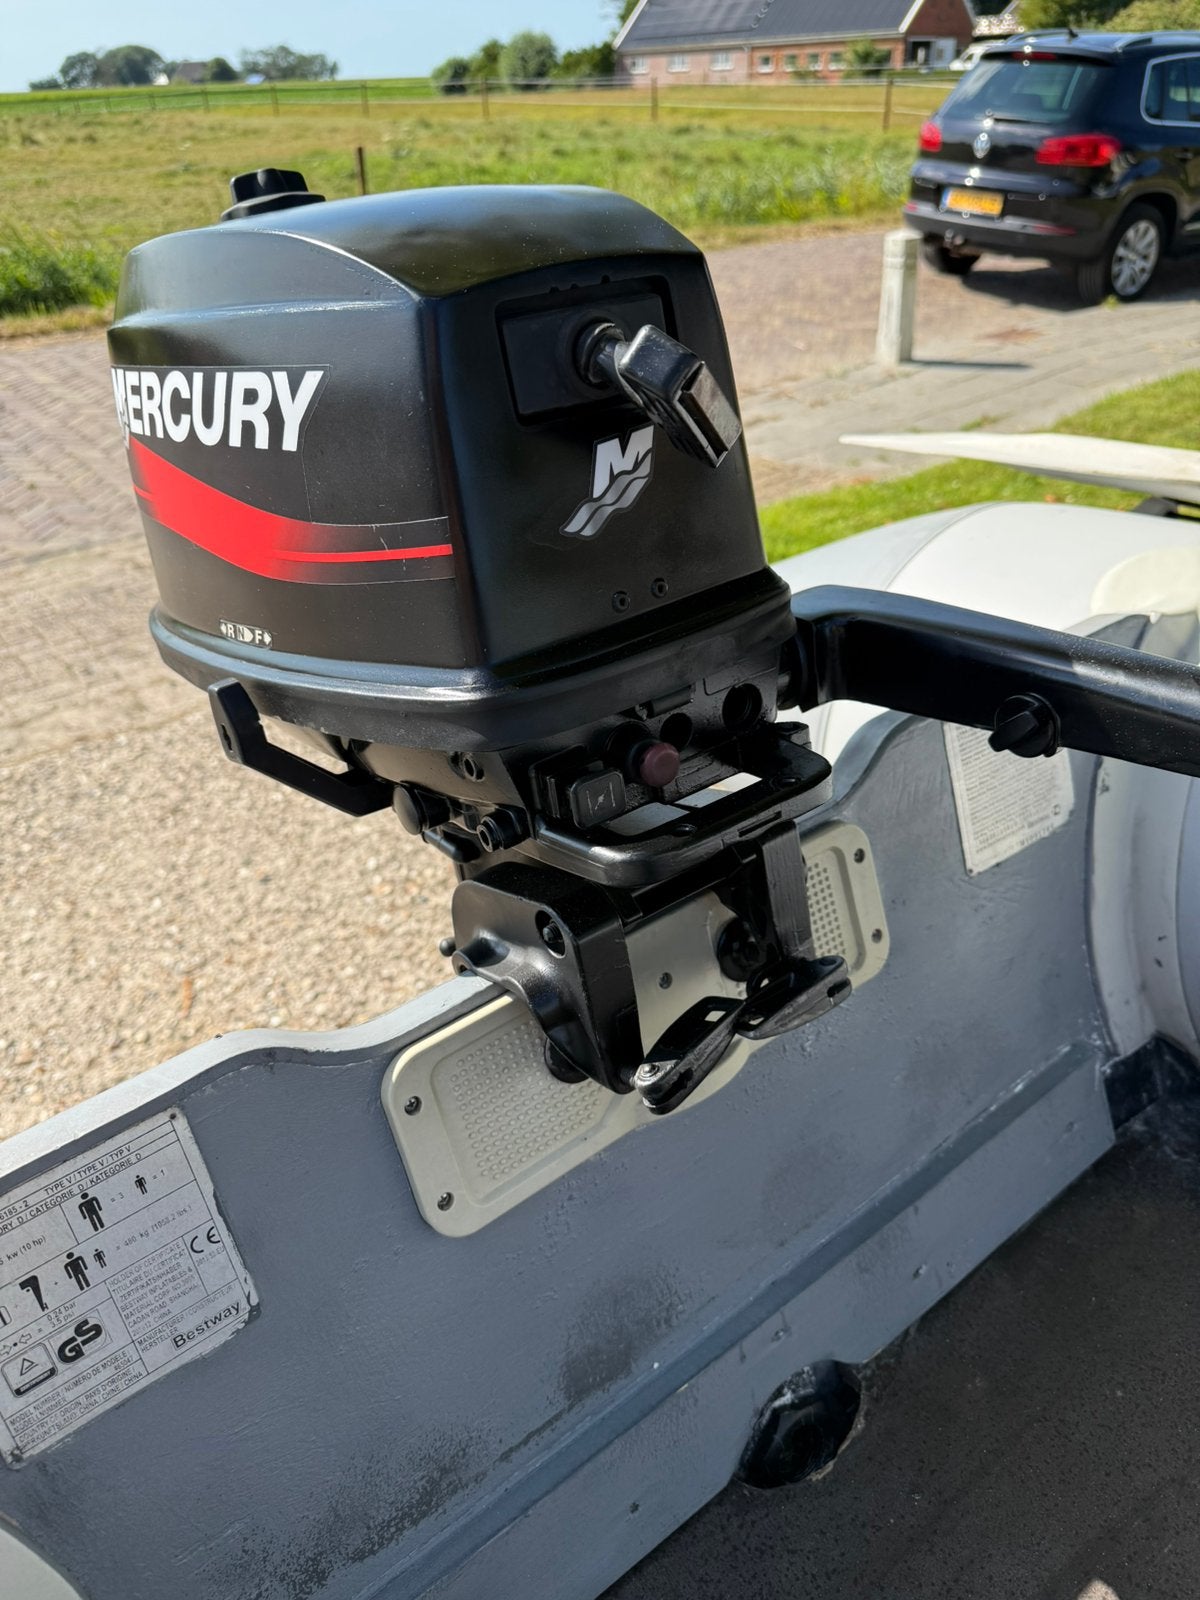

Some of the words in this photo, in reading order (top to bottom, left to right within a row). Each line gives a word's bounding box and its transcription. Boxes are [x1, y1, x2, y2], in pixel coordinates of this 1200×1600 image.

[111, 368, 324, 452] MERCURY
[226, 623, 235, 639] R
[254, 629, 263, 644] F
[16, 1215, 24, 1224] D
[77, 1183, 84, 1191] D
[88, 1157, 132, 1184] KATEGORIE
[134, 1152, 142, 1160] D
[22, 1199, 29, 1207] 2
[44, 1180, 65, 1195] TYPE
[65, 1176, 73, 1184] V
[77, 1162, 98, 1177] TYPE
[97, 1159, 105, 1167] V
[109, 1148, 125, 1160] TYP
[124, 1144, 132, 1152] V
[6, 1249, 19, 1261] kw
[18, 1242, 33, 1255] (10
[31, 1233, 47, 1248] hp)
[189, 1226, 221, 1253] CE
[46, 1307, 63, 1321] 0.24
[62, 1299, 76, 1312] bar
[119, 1291, 149, 1312] BESTWAY
[147, 1268, 187, 1295] INFLATABLES
[123, 1298, 154, 1320] MATERIAL
[49, 1316, 62, 1328] 3.5
[57, 1318, 103, 1364] GS
[136, 1313, 185, 1346] MANUFACTURER
[139, 1326, 179, 1353] HERSTELLER
[172, 1301, 241, 1348] Bestway
[8, 1407, 33, 1426] MODEL
[32, 1390, 61, 1411] NUMBER
[90, 1366, 101, 1376] DE
[78, 1398, 98, 1414] CHINA
[123, 1370, 143, 1386] CHINA
[18, 1419, 50, 1442] COUNTRY
[58, 1399, 82, 1417] ORIGIN
[83, 1387, 101, 1401] PAYS
